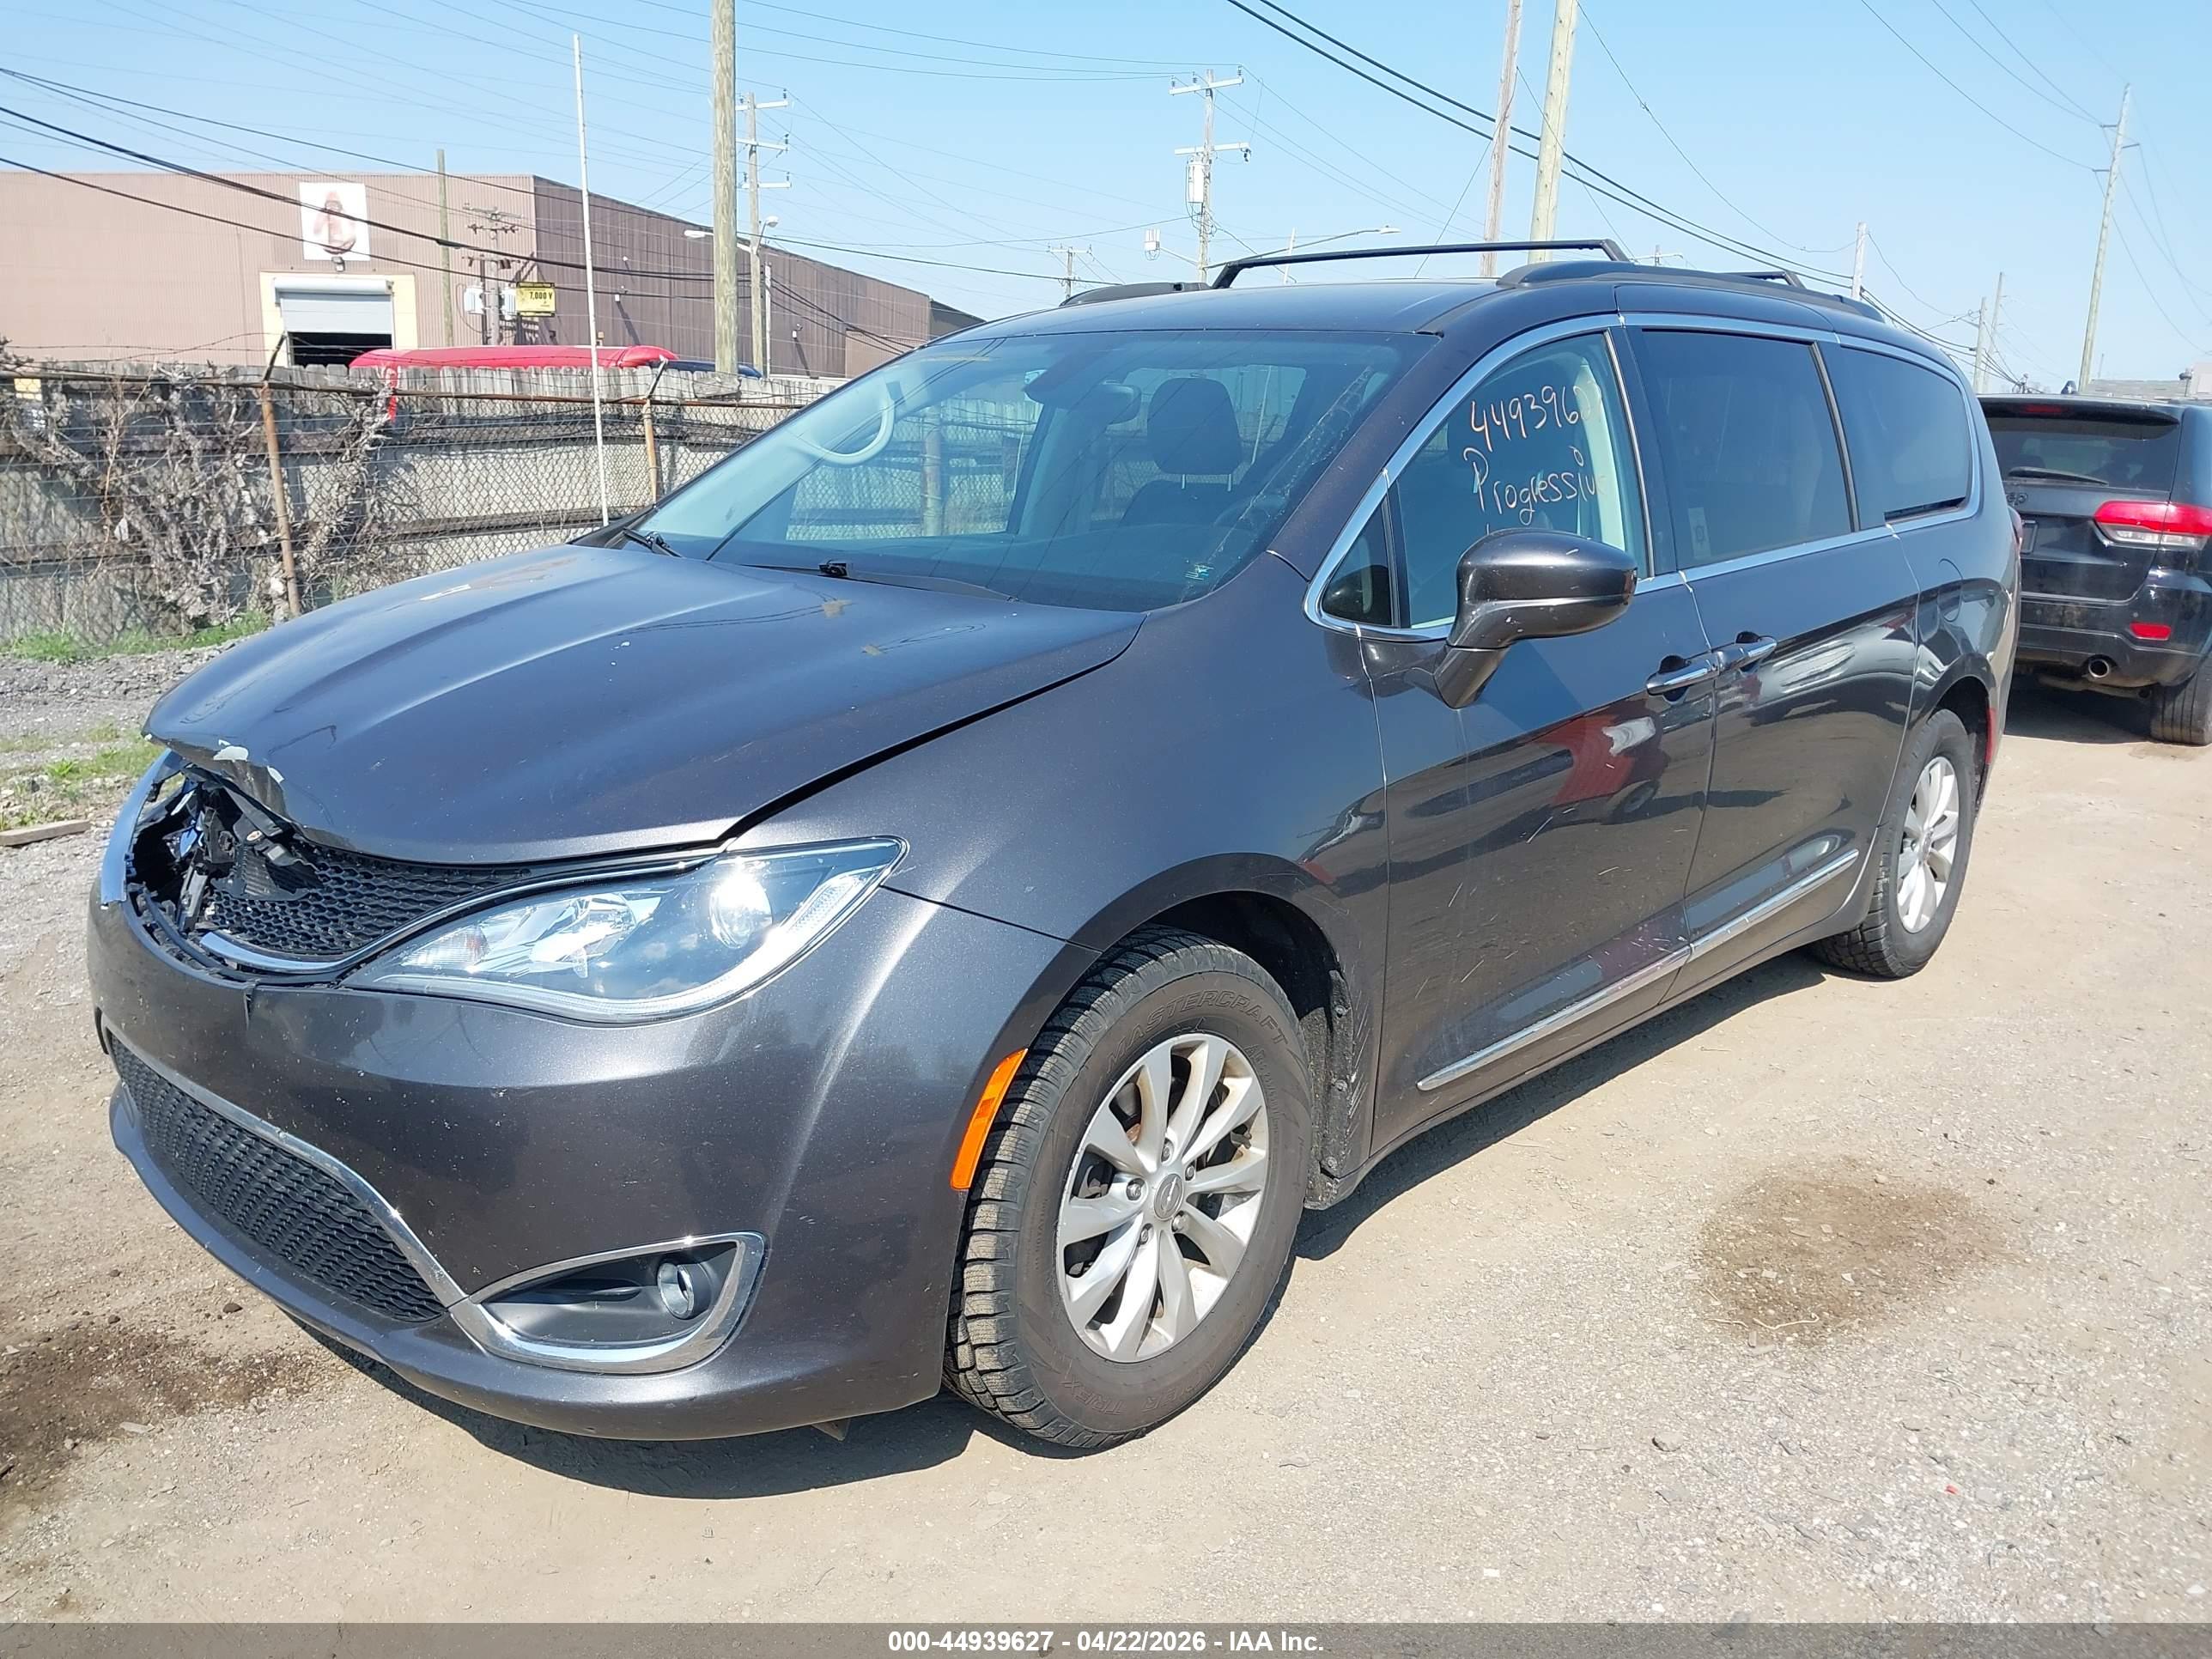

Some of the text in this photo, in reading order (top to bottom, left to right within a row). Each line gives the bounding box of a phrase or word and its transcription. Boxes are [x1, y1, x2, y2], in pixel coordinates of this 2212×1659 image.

[530, 291, 547, 300] 7,000
[2006, 492, 2028, 506] ep
[1107, 989, 1289, 1073] MASTERCRAFT
